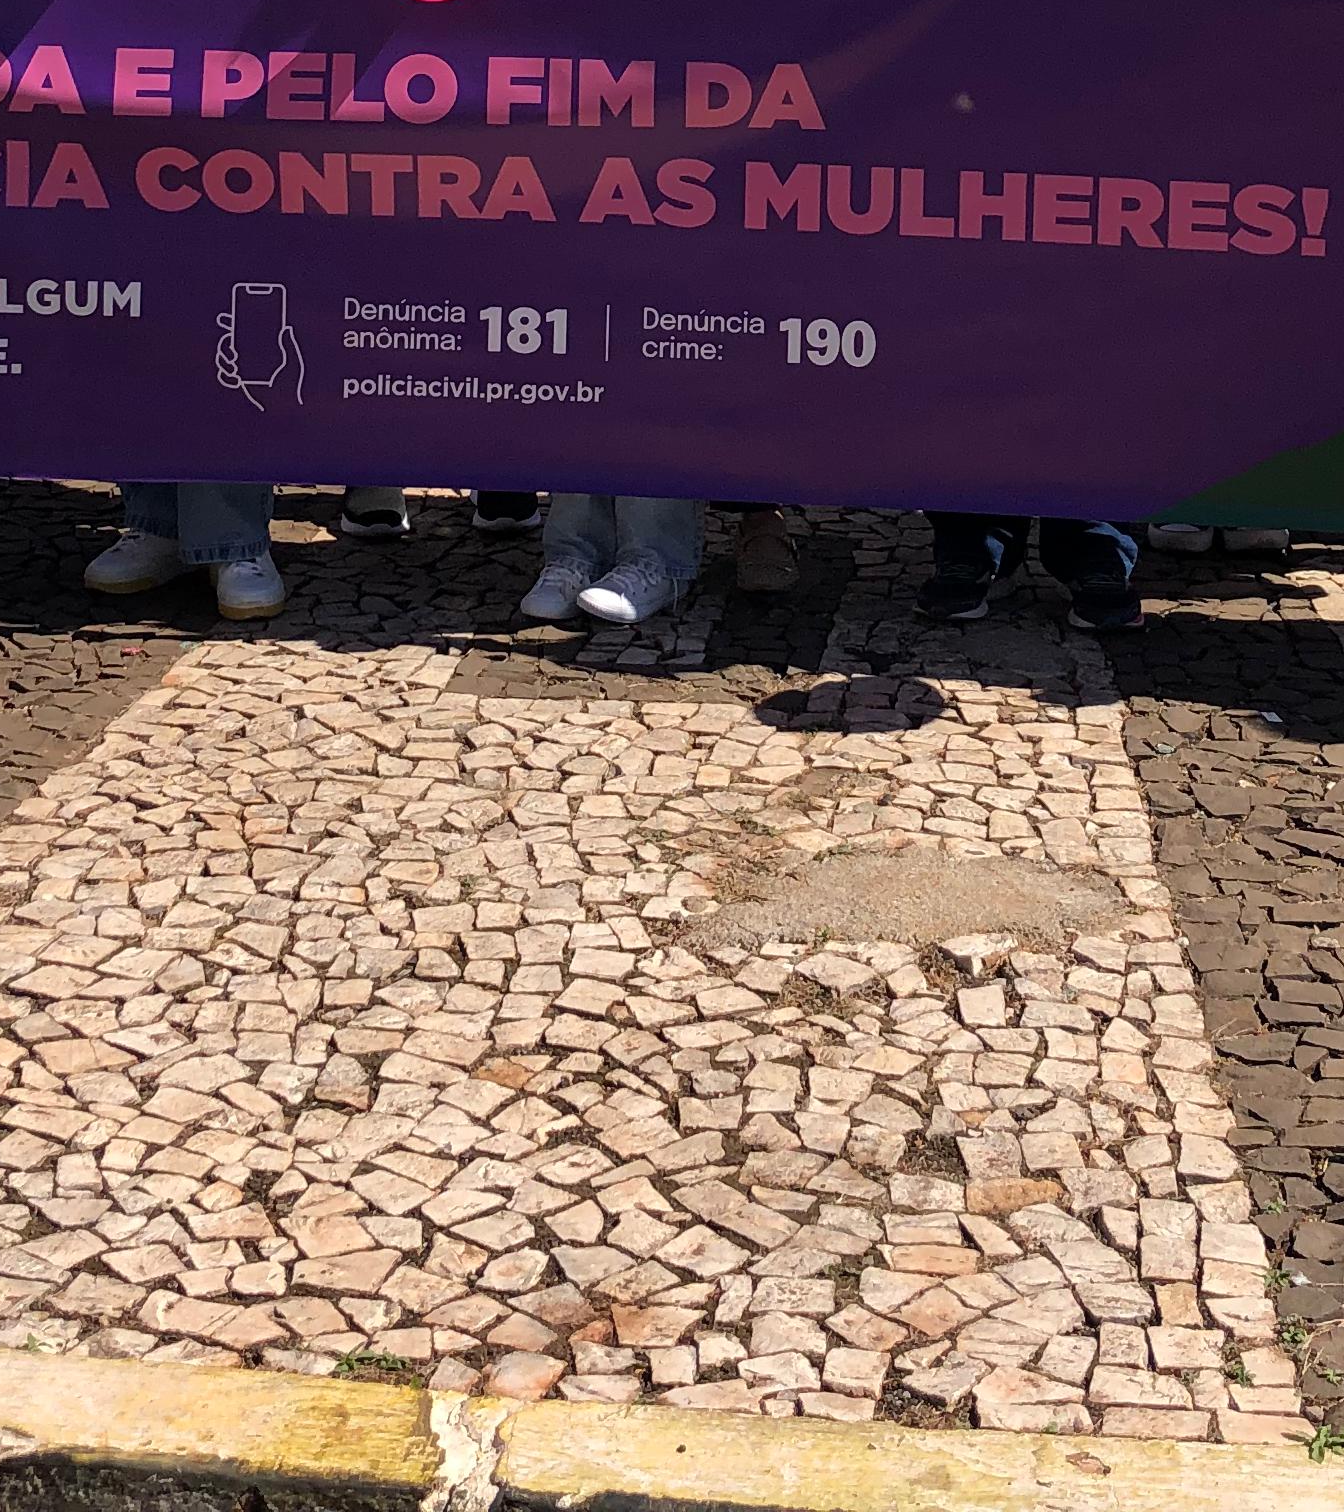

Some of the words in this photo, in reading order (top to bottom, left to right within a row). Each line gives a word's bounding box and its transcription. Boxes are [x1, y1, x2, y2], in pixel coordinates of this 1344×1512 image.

[112, 47, 176, 118] E
[201, 50, 457, 124] PELO
[485, 56, 656, 129] FIM
[683, 63, 826, 131] DA
[134, 146, 556, 222] CONTRA
[579, 157, 717, 229] AS
[743, 161, 1330, 257] MULHERES!
[343, 326, 462, 351] anônima:
[344, 297, 465, 323] Denúncia
[479, 306, 567, 354] 181
[642, 335, 723, 361] crime:
[643, 306, 765, 334] Denúncia
[779, 317, 877, 368] 190
[343, 374, 605, 404] policiacivil.pr.gov.br
